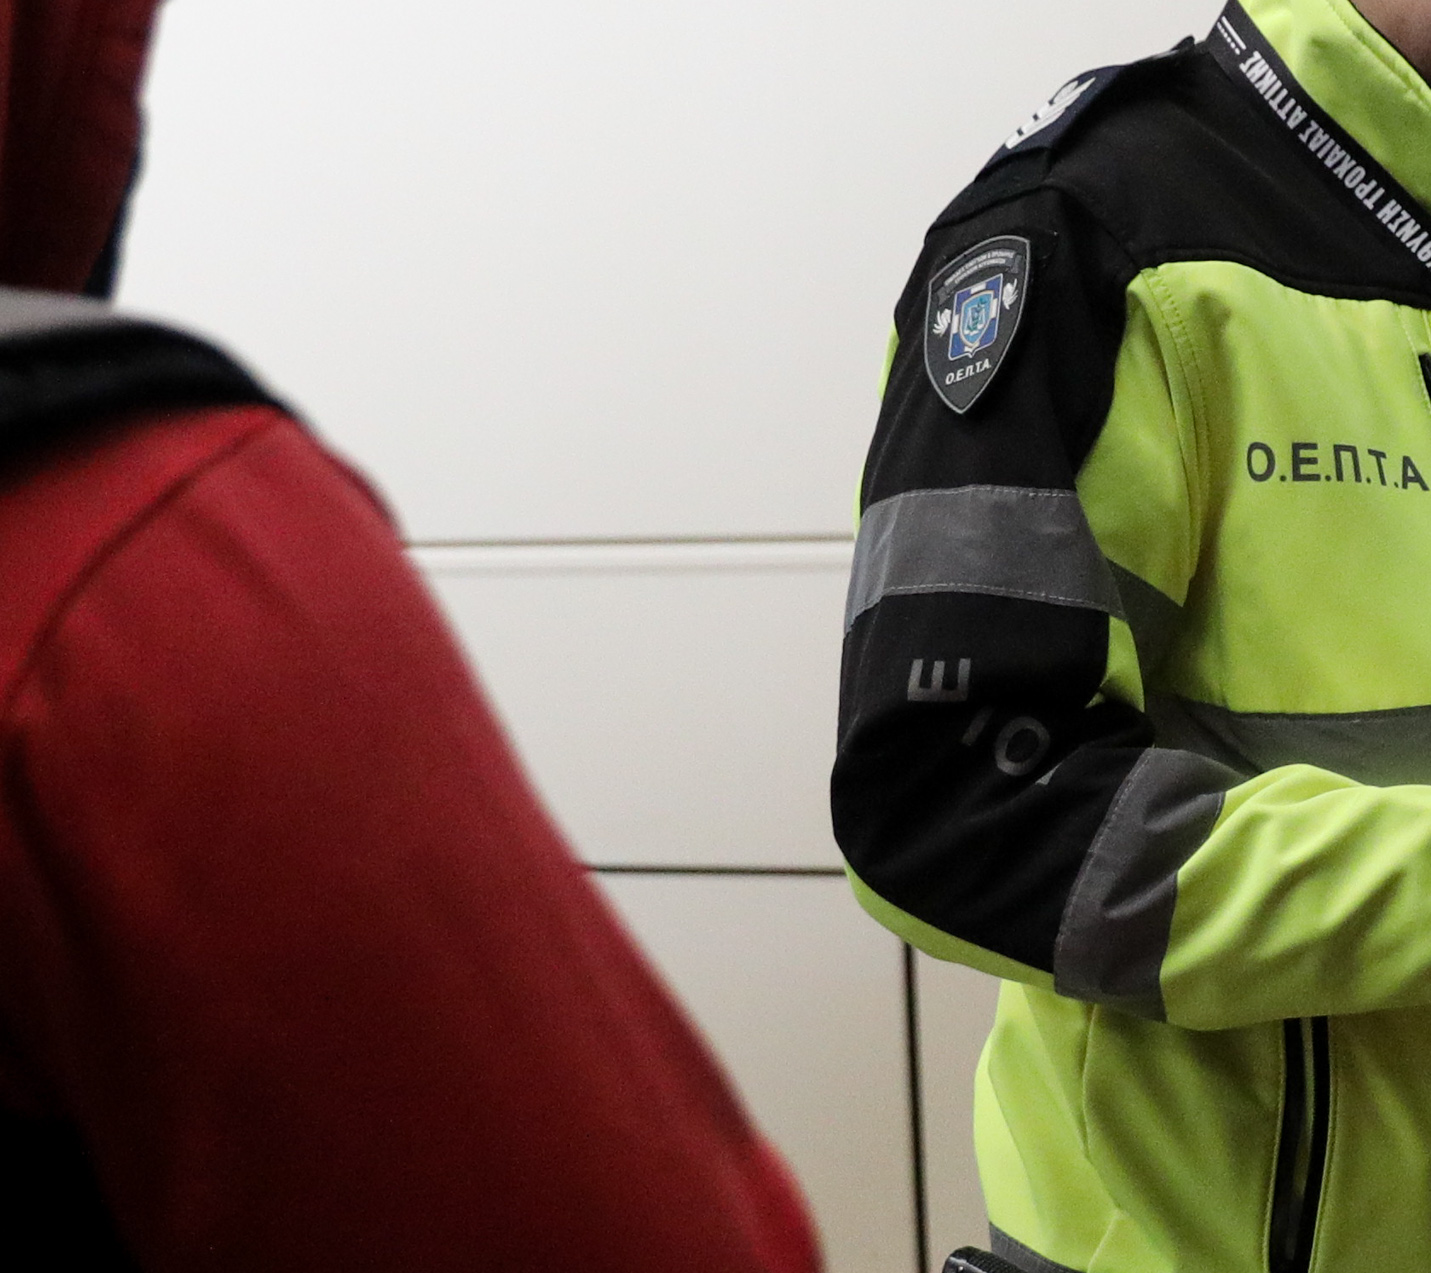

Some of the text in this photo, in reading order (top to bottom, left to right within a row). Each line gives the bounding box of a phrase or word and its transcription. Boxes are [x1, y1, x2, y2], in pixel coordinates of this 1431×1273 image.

[1239, 50, 1308, 129] ΑΤΤΙΚΗΣ
[1298, 119, 1385, 210] ΤΡΟΧΑΙΑΣ
[945, 358, 992, 386] Ο.Ε.Π.Τ.Α.
[1246, 441, 1430, 492] Ο.Ε.Π.Τ.Α
